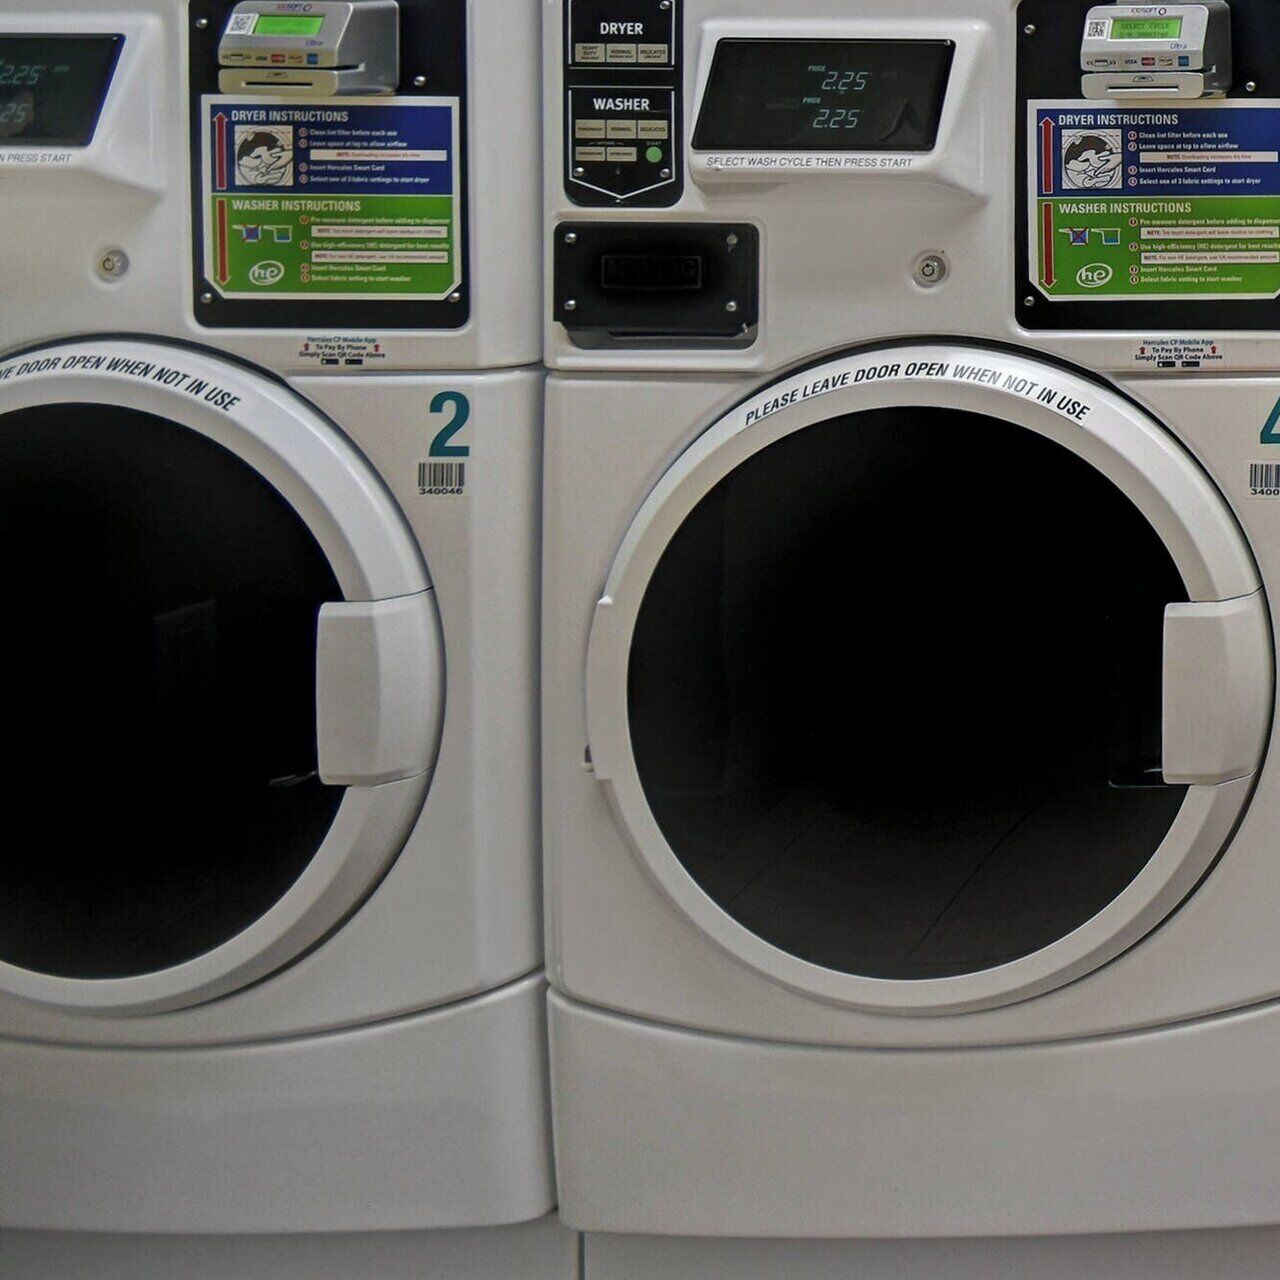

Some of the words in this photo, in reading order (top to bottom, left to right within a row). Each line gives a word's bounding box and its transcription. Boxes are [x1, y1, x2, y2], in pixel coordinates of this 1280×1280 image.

[600, 22, 643, 35] DRYER
[821, 72, 868, 90] 2.25
[593, 98, 650, 110] WASHER
[232, 111, 266, 121] DRYER
[269, 111, 349, 121] INSTRUCTIONS
[813, 109, 860, 128] 2.25
[1059, 114, 1094, 125] DRYER
[1097, 114, 1179, 125] INSTRUCTIONS
[7, 154, 38, 163] PRESS
[39, 154, 72, 163] START
[706, 156, 745, 166] SELECT
[747, 156, 777, 166] WASH
[779, 156, 813, 166] CYCLE
[814, 157, 842, 166] THEN
[843, 158, 878, 167] PRESS
[879, 158, 914, 167] START
[232, 200, 279, 211] WASHER
[281, 200, 361, 211] INSTRUCTIONS
[1059, 203, 1107, 214] WASHER
[1110, 203, 1192, 214] INSTRUCTIONS
[16, 357, 61, 376] DOOR
[62, 355, 107, 370] OPEN
[106, 357, 151, 377] WHEN
[152, 367, 190, 388] NOT
[185, 377, 210, 395] IN
[204, 387, 242, 412] USE
[745, 389, 800, 425] PLEASE
[802, 372, 851, 398] LEAVE
[854, 364, 901, 383] DOOR
[905, 362, 950, 377] OPEN
[952, 364, 1002, 386] WHEN
[1002, 374, 1039, 396] NOT
[1036, 386, 1058, 405] IN
[1056, 395, 1091, 421] USE
[428, 391, 470, 457] 2
